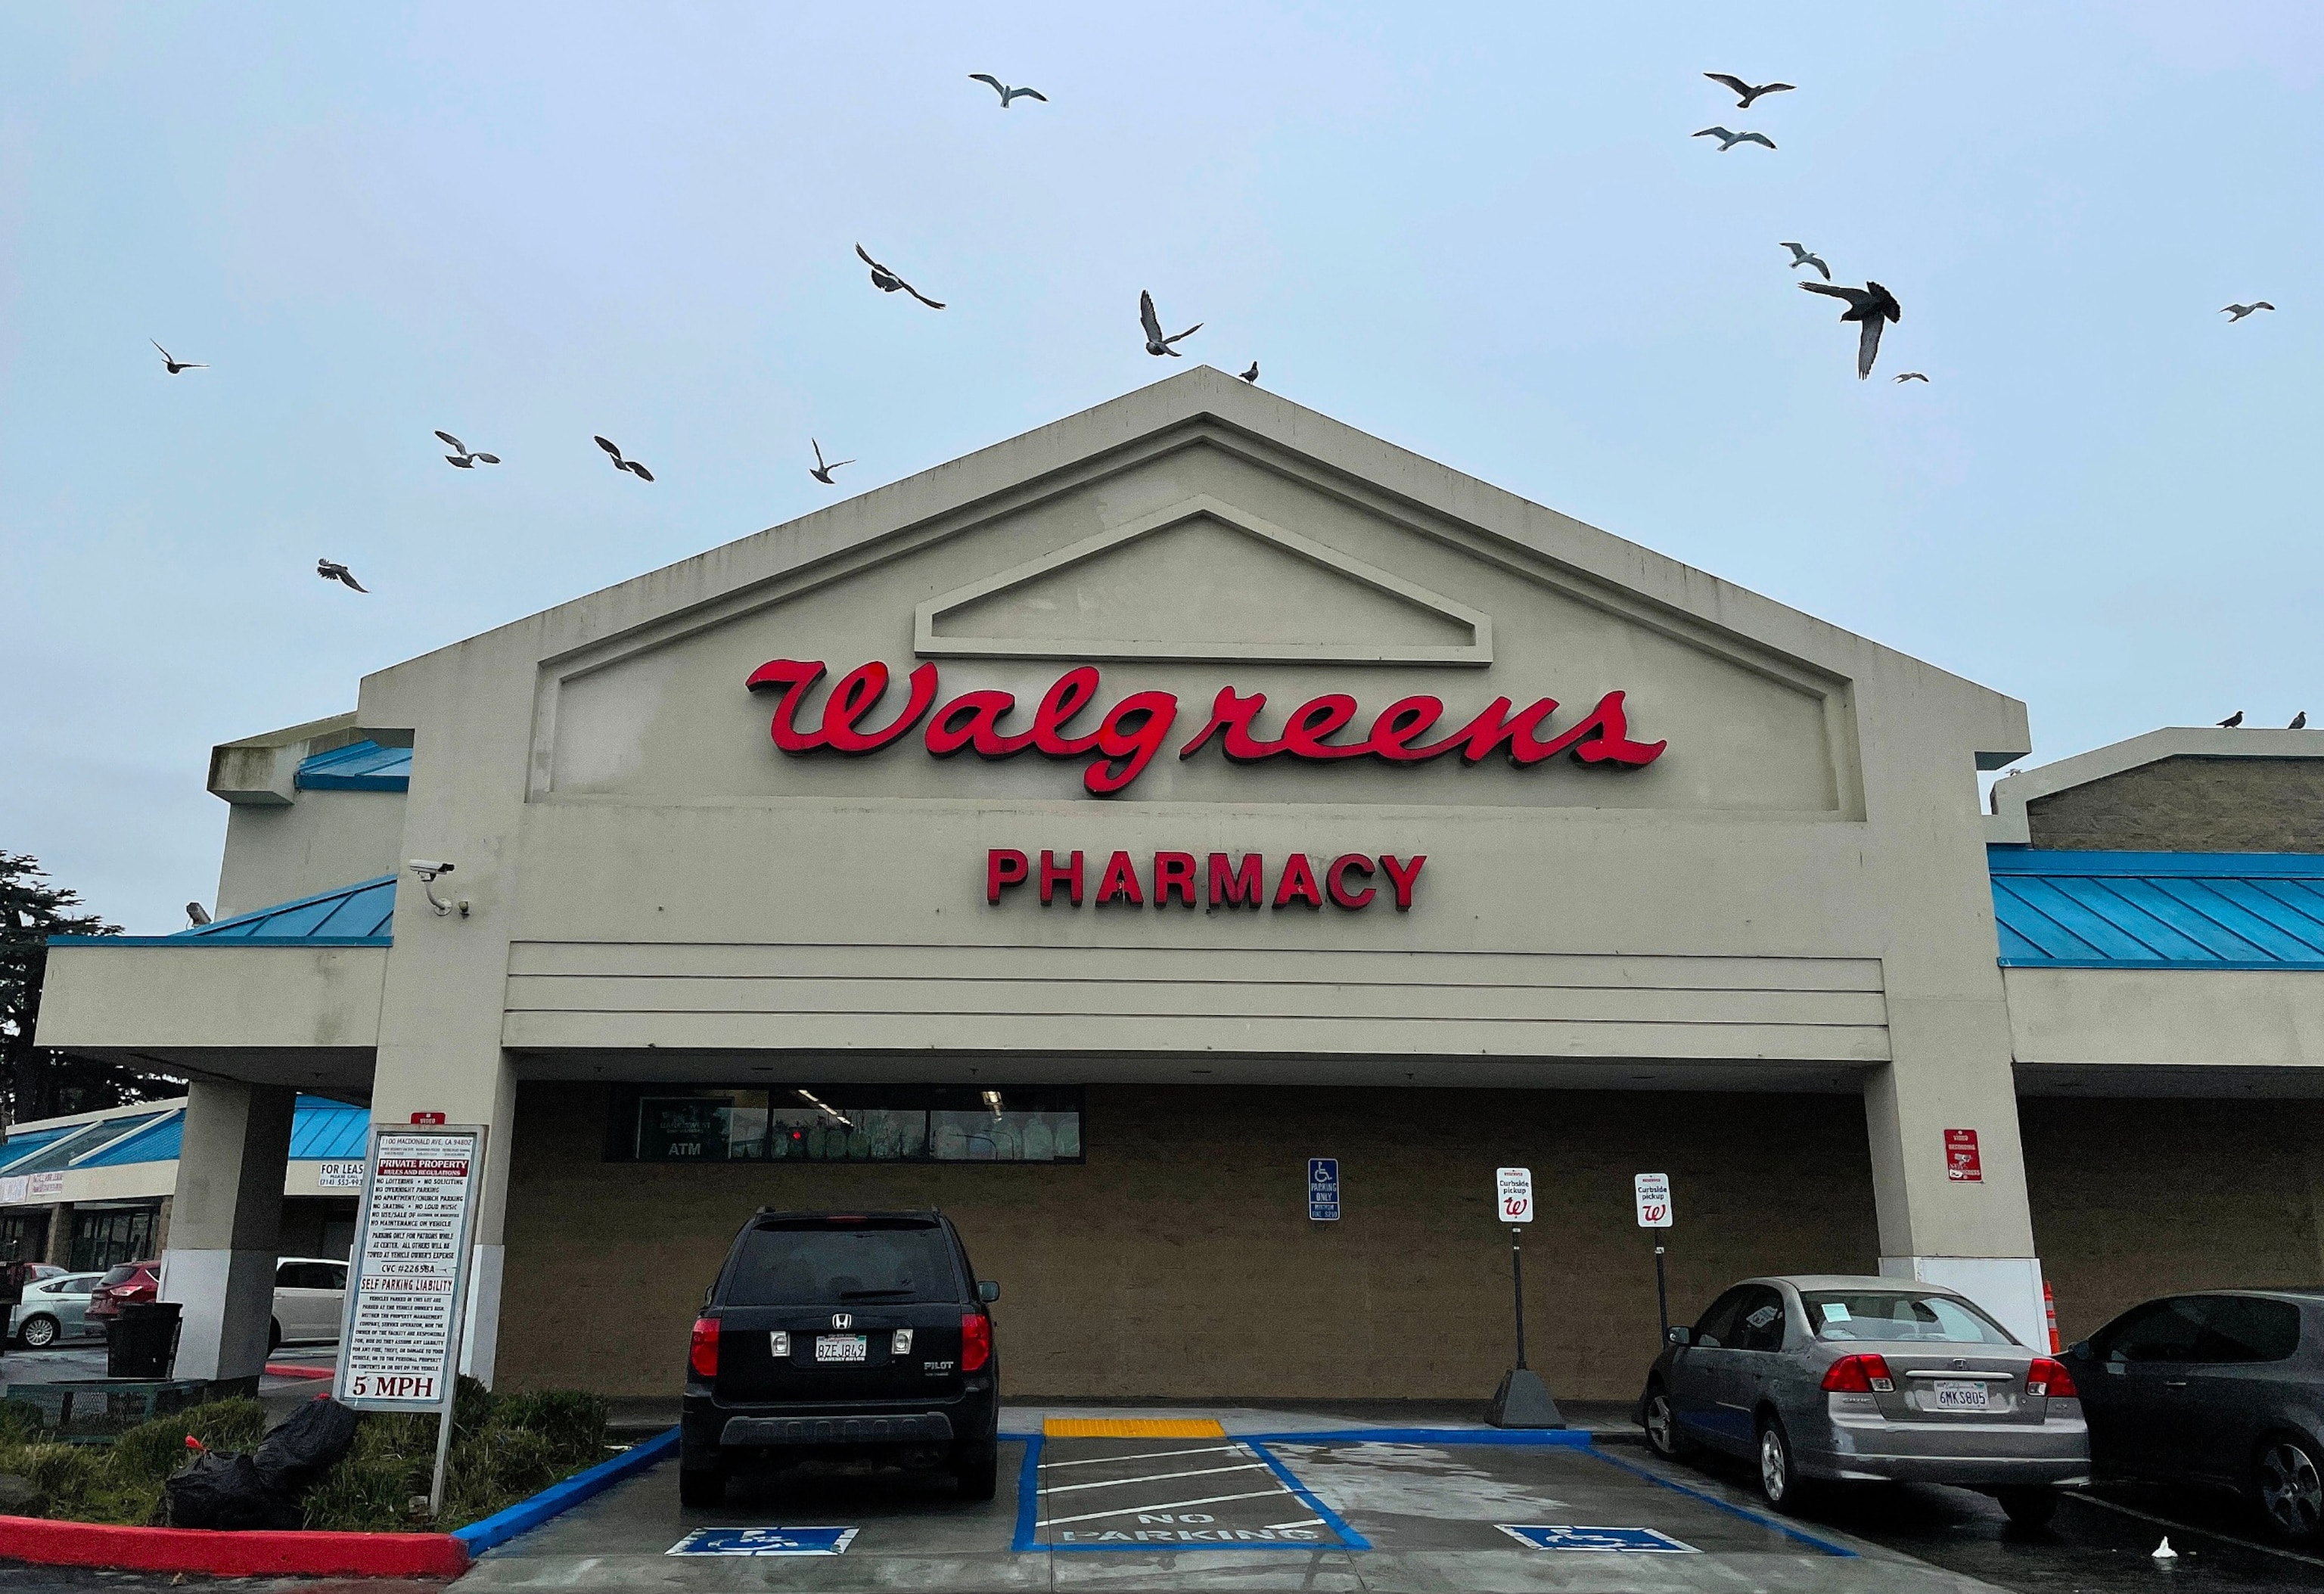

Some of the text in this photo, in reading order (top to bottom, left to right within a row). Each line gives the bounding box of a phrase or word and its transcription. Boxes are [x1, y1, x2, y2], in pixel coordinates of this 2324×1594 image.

[745, 658, 1667, 795] Walgreens
[988, 848, 1428, 913] PHARMACY
[668, 1143, 701, 1156] ATM
[322, 1164, 363, 1174] FOR LEAS
[418, 1160, 467, 1168] PROPERTY
[1311, 1182, 1337, 1192] PARKING
[1316, 1192, 1331, 1201] ONLY
[1642, 1192, 1664, 1201] pickup
[362, 1279, 452, 1291] SELF PARKING LIABILITY
[819, 1344, 864, 1356] 8ZEJ849
[924, 1362, 954, 1370] PILOT
[353, 1376, 433, 1397] 5 MPH
[1940, 1391, 1985, 1404] 6MKS805
[1137, 1514, 1215, 1524] NO
[1062, 1529, 1319, 1542] PARKING
